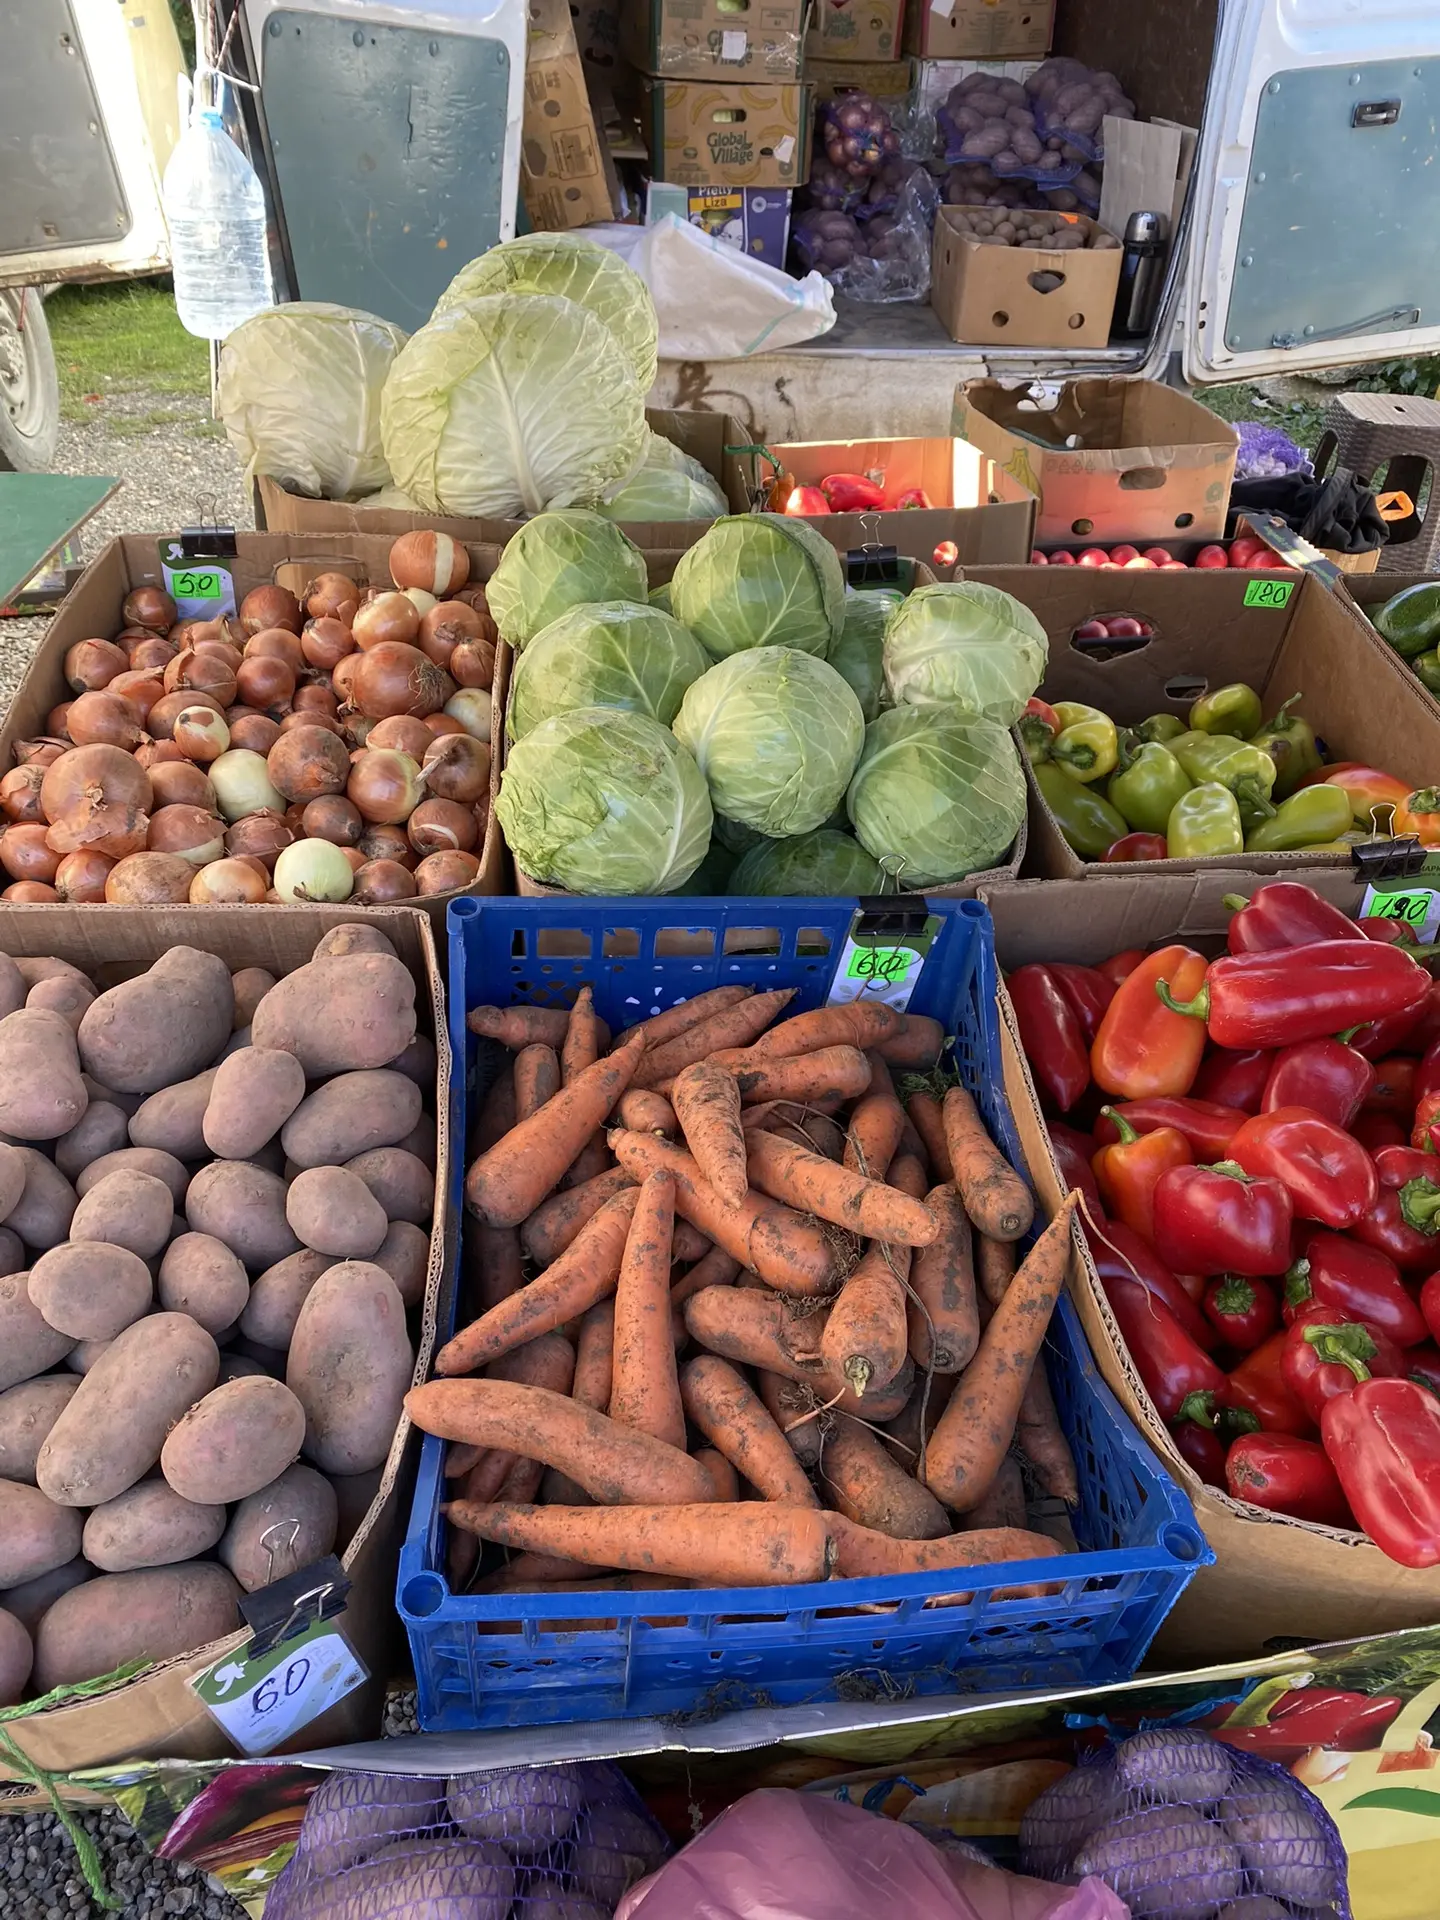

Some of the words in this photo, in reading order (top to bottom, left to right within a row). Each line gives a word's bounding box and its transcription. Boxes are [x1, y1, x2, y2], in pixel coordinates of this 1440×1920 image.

[707, 130, 749, 148] Global
[710, 148, 754, 165] Village
[704, 197, 728, 208] Liza
[178, 572, 213, 594] 50
[856, 952, 903, 975] 60
[252, 1658, 311, 1714] 60
